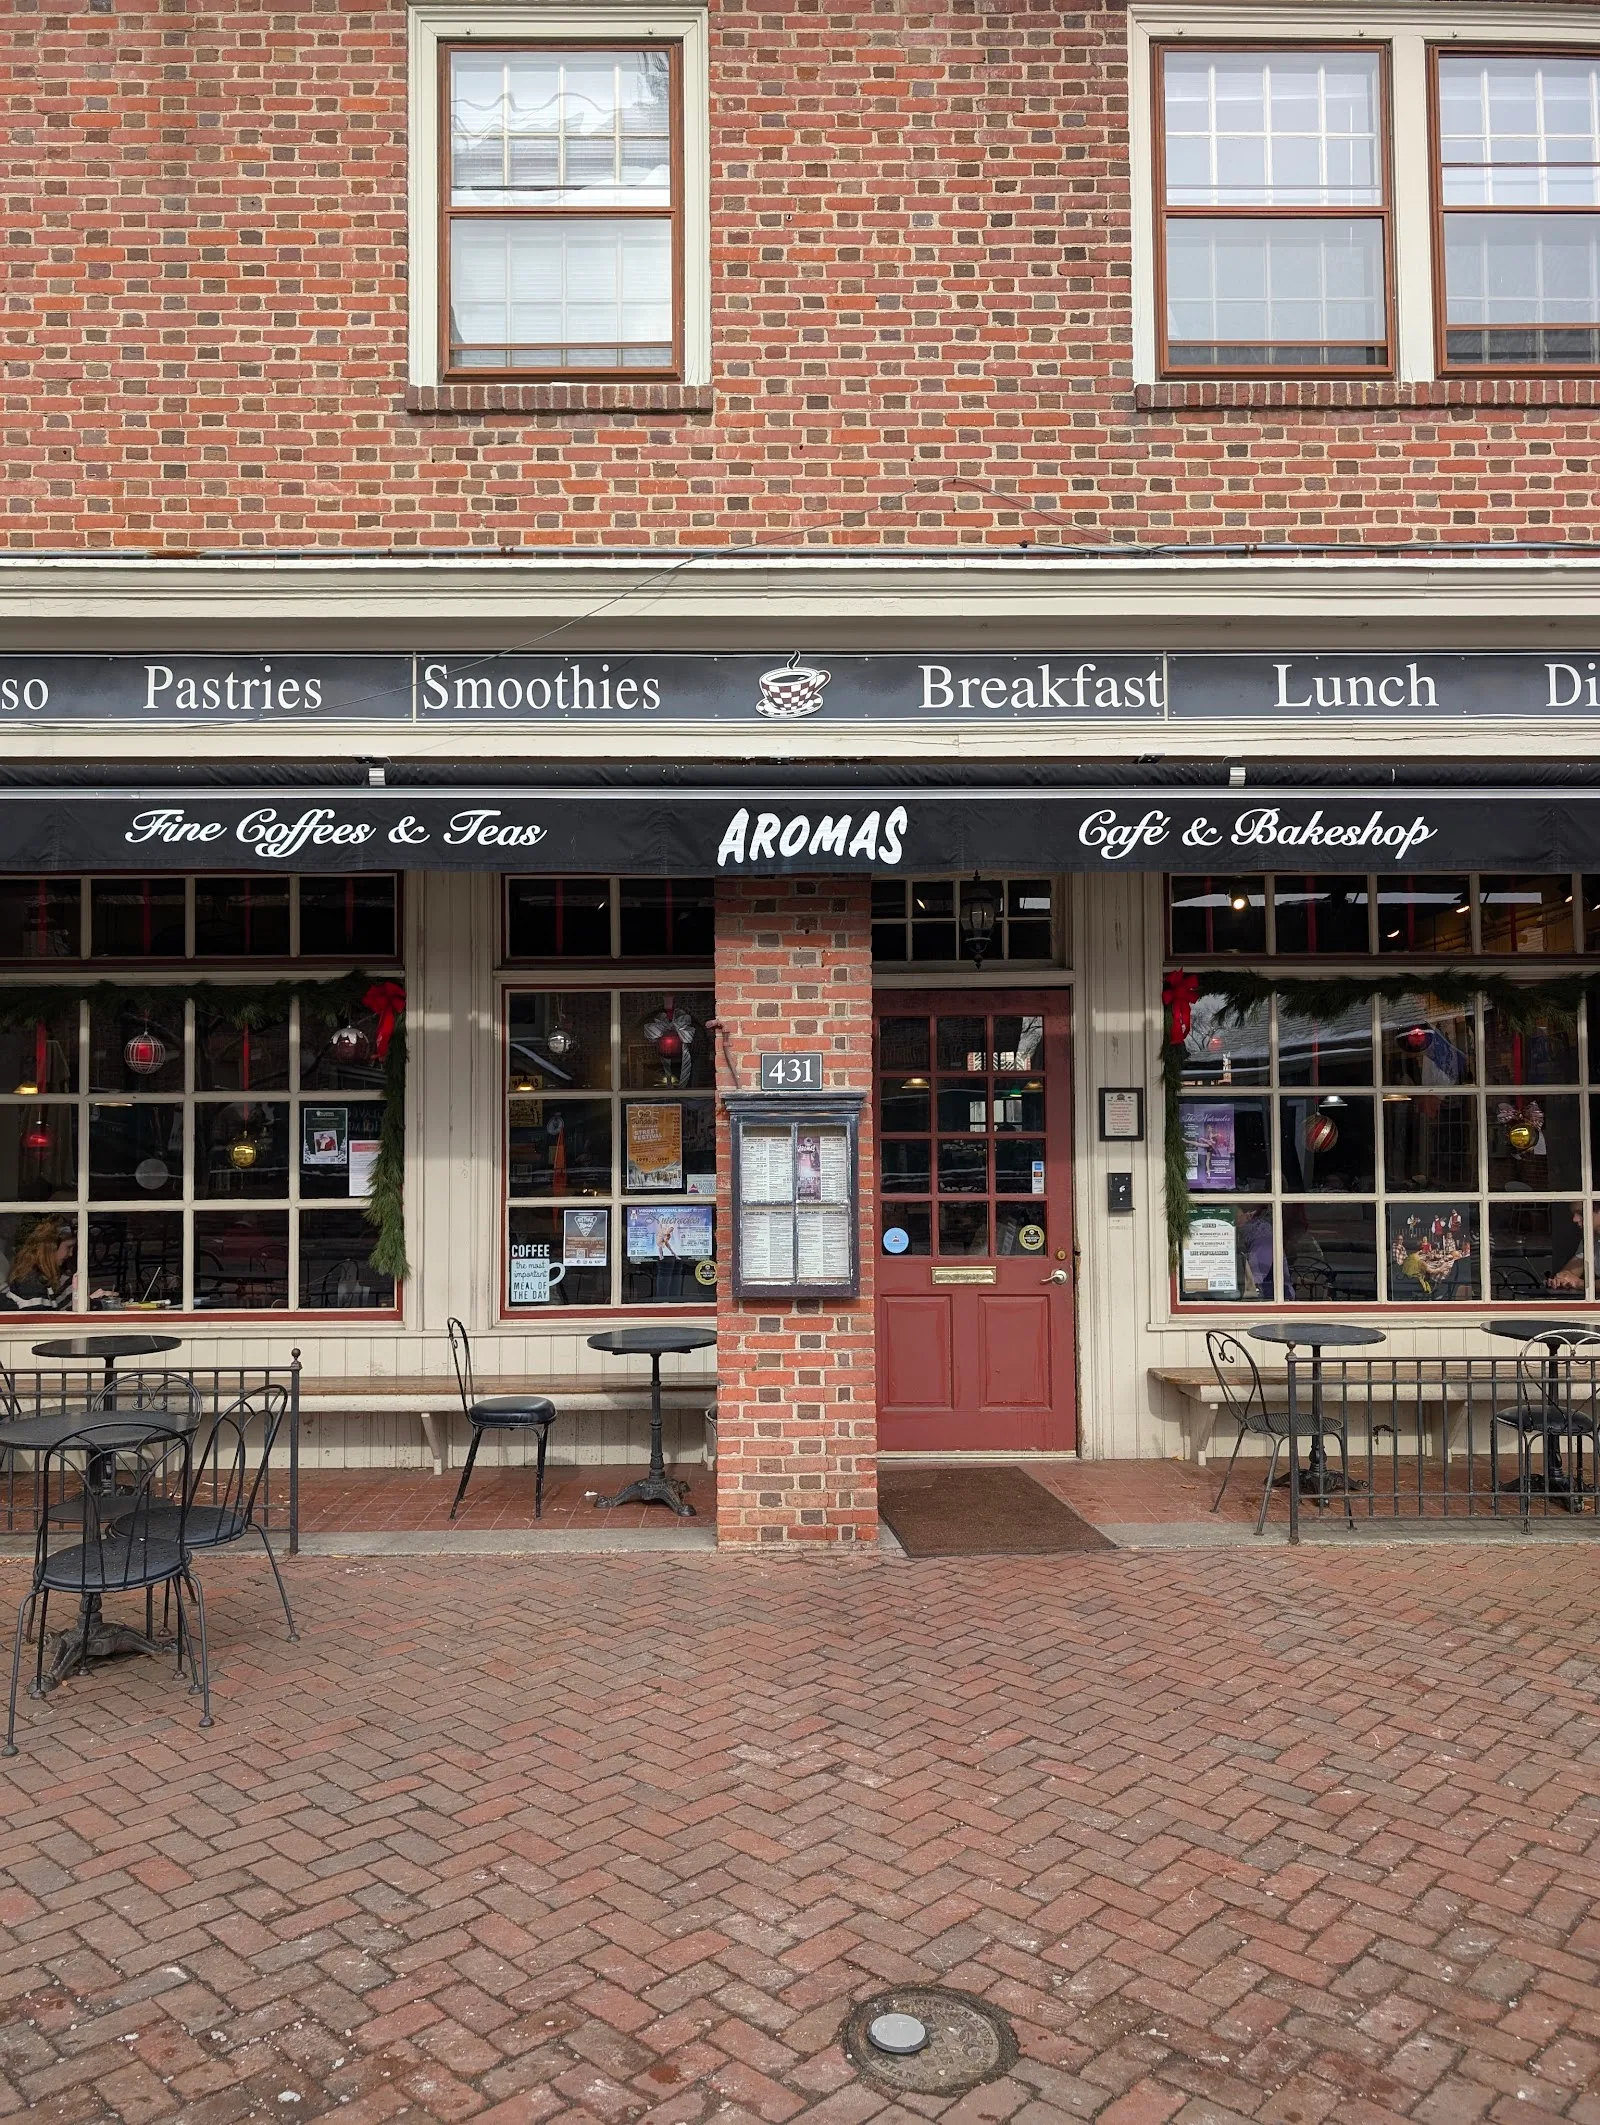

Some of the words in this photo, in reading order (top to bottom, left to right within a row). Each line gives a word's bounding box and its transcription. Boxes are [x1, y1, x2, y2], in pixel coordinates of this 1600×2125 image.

[2, 679, 49, 710] so
[143, 665, 323, 710] Pastries
[423, 664, 661, 710] Smoothies
[918, 664, 1166, 709] Breakfast
[1273, 663, 1439, 708] Lunch
[1545, 663, 1600, 707] Di
[124, 809, 228, 844] Fine
[236, 809, 376, 858] Coffees
[388, 816, 431, 844] &
[443, 809, 548, 846] Teas
[717, 805, 908, 866] AROMAS
[1078, 809, 1170, 860] Café
[1182, 818, 1223, 846] &
[1231, 808, 1439, 860] Bakeshop
[768, 1058, 814, 1085] 431
[511, 1244, 550, 1257] COFFEE
[515, 1261, 527, 1269] the
[528, 1260, 546, 1269] most
[513, 1282, 534, 1290] MEAL
[537, 1281, 547, 1290] OF
[513, 1291, 528, 1299] THE
[533, 1290, 547, 1299] DAY
[514, 1270, 548, 1281] important
